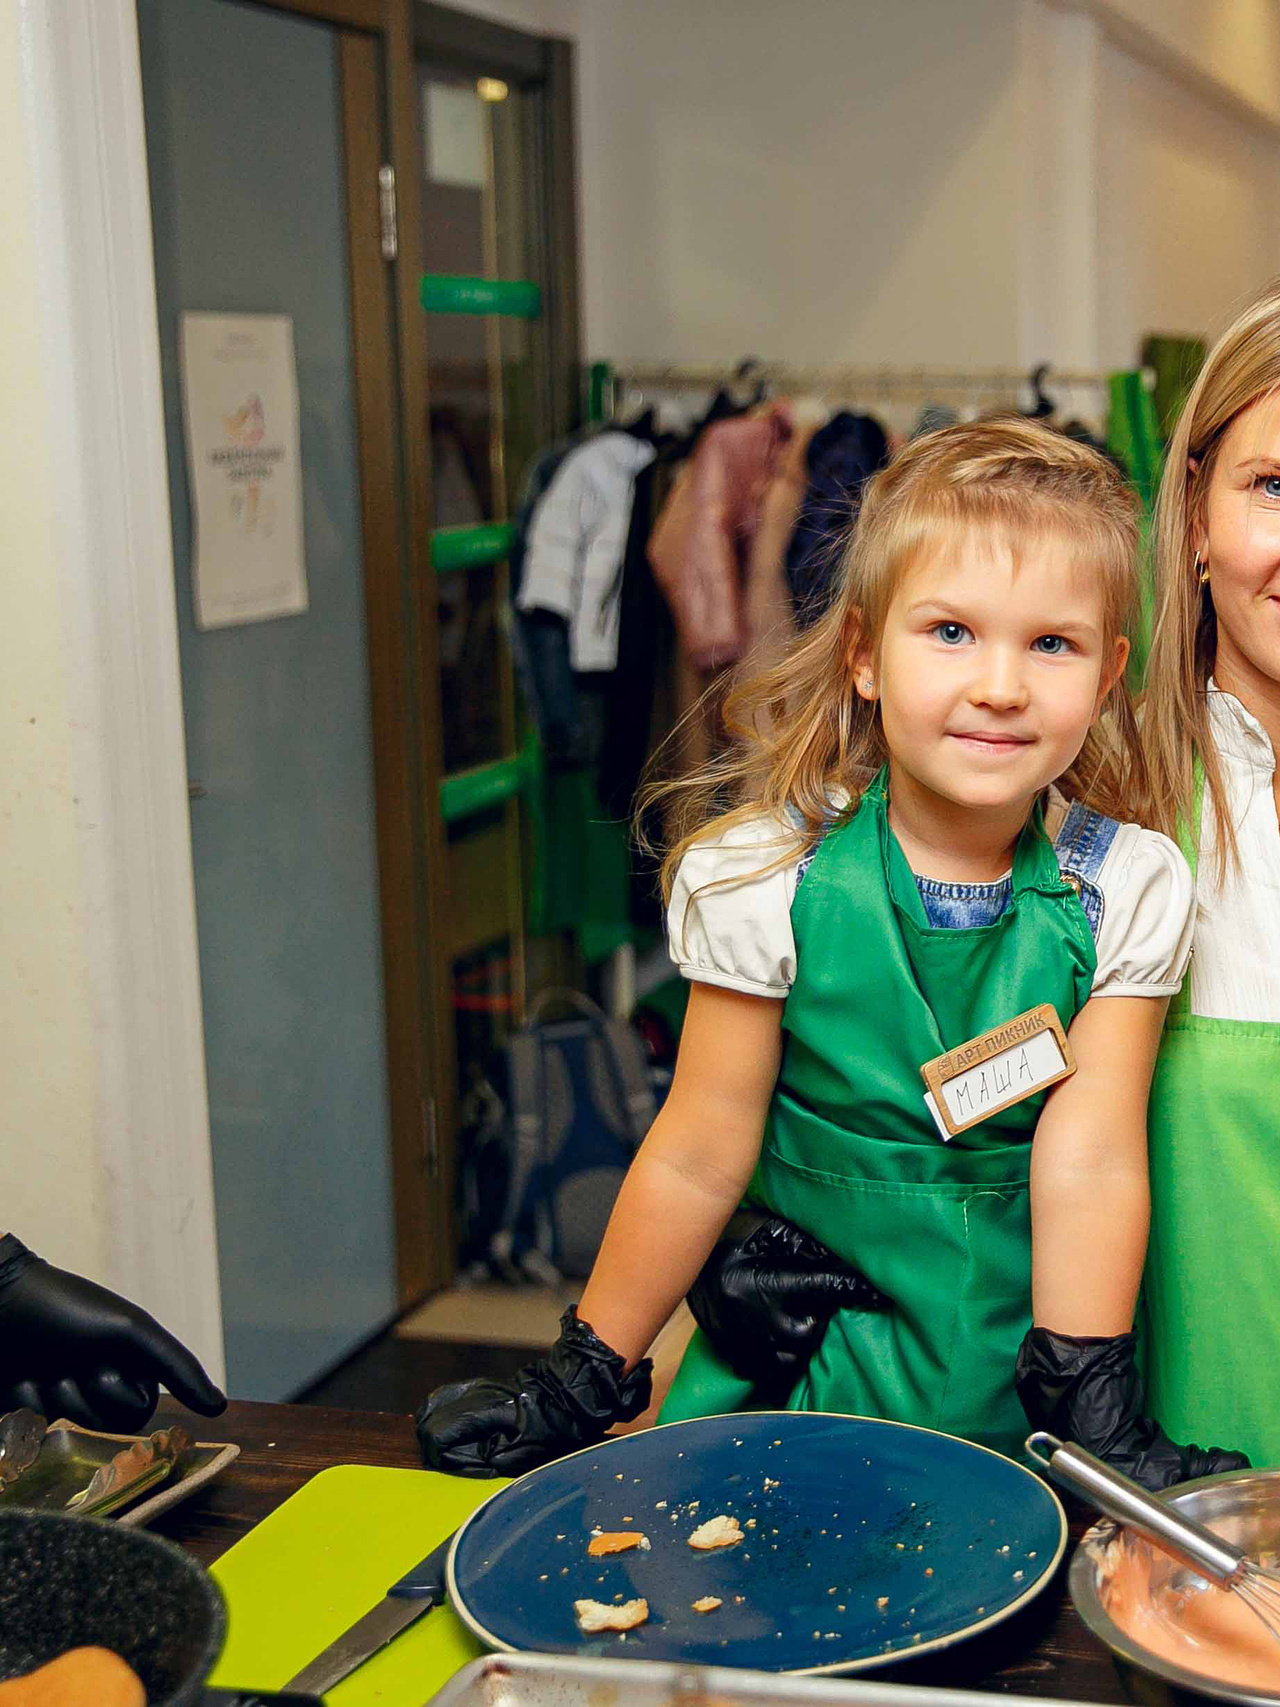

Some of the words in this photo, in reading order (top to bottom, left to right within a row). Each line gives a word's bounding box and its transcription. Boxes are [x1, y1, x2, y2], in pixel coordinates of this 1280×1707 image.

[957, 1043, 986, 1069] АРТ
[984, 1012, 1046, 1051] ПИКНИК
[955, 1047, 1034, 1116] МАША
